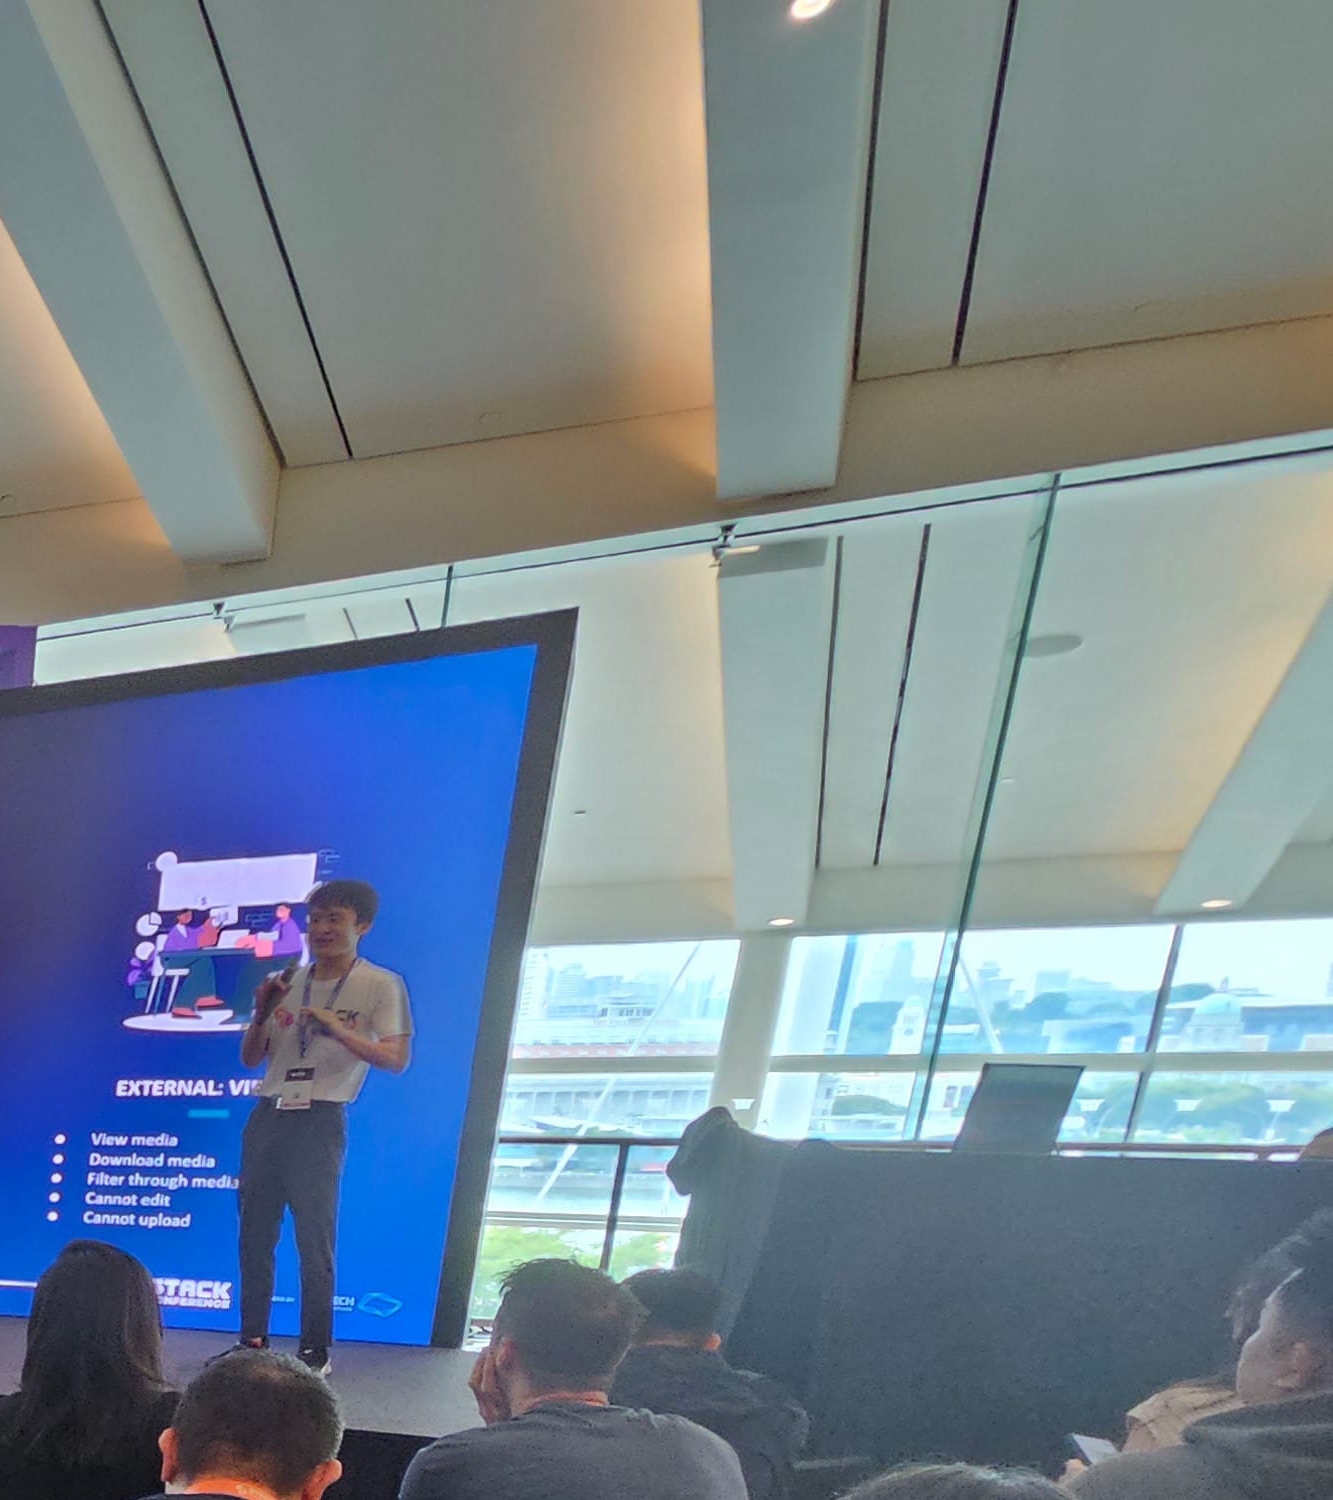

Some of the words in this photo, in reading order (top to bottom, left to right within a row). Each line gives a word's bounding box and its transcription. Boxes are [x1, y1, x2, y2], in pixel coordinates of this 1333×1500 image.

[115, 1079, 224, 1097] EXTERNAL:
[91, 1132, 129, 1146] View
[131, 1133, 179, 1147] media
[89, 1153, 165, 1168] Download
[167, 1153, 216, 1168] media
[87, 1172, 125, 1187] Filter
[128, 1172, 188, 1190] through
[191, 1174, 240, 1190] media
[85, 1192, 138, 1206] Cannot
[140, 1192, 171, 1207] edit
[83, 1211, 136, 1226] Cannot
[138, 1212, 192, 1229] upload
